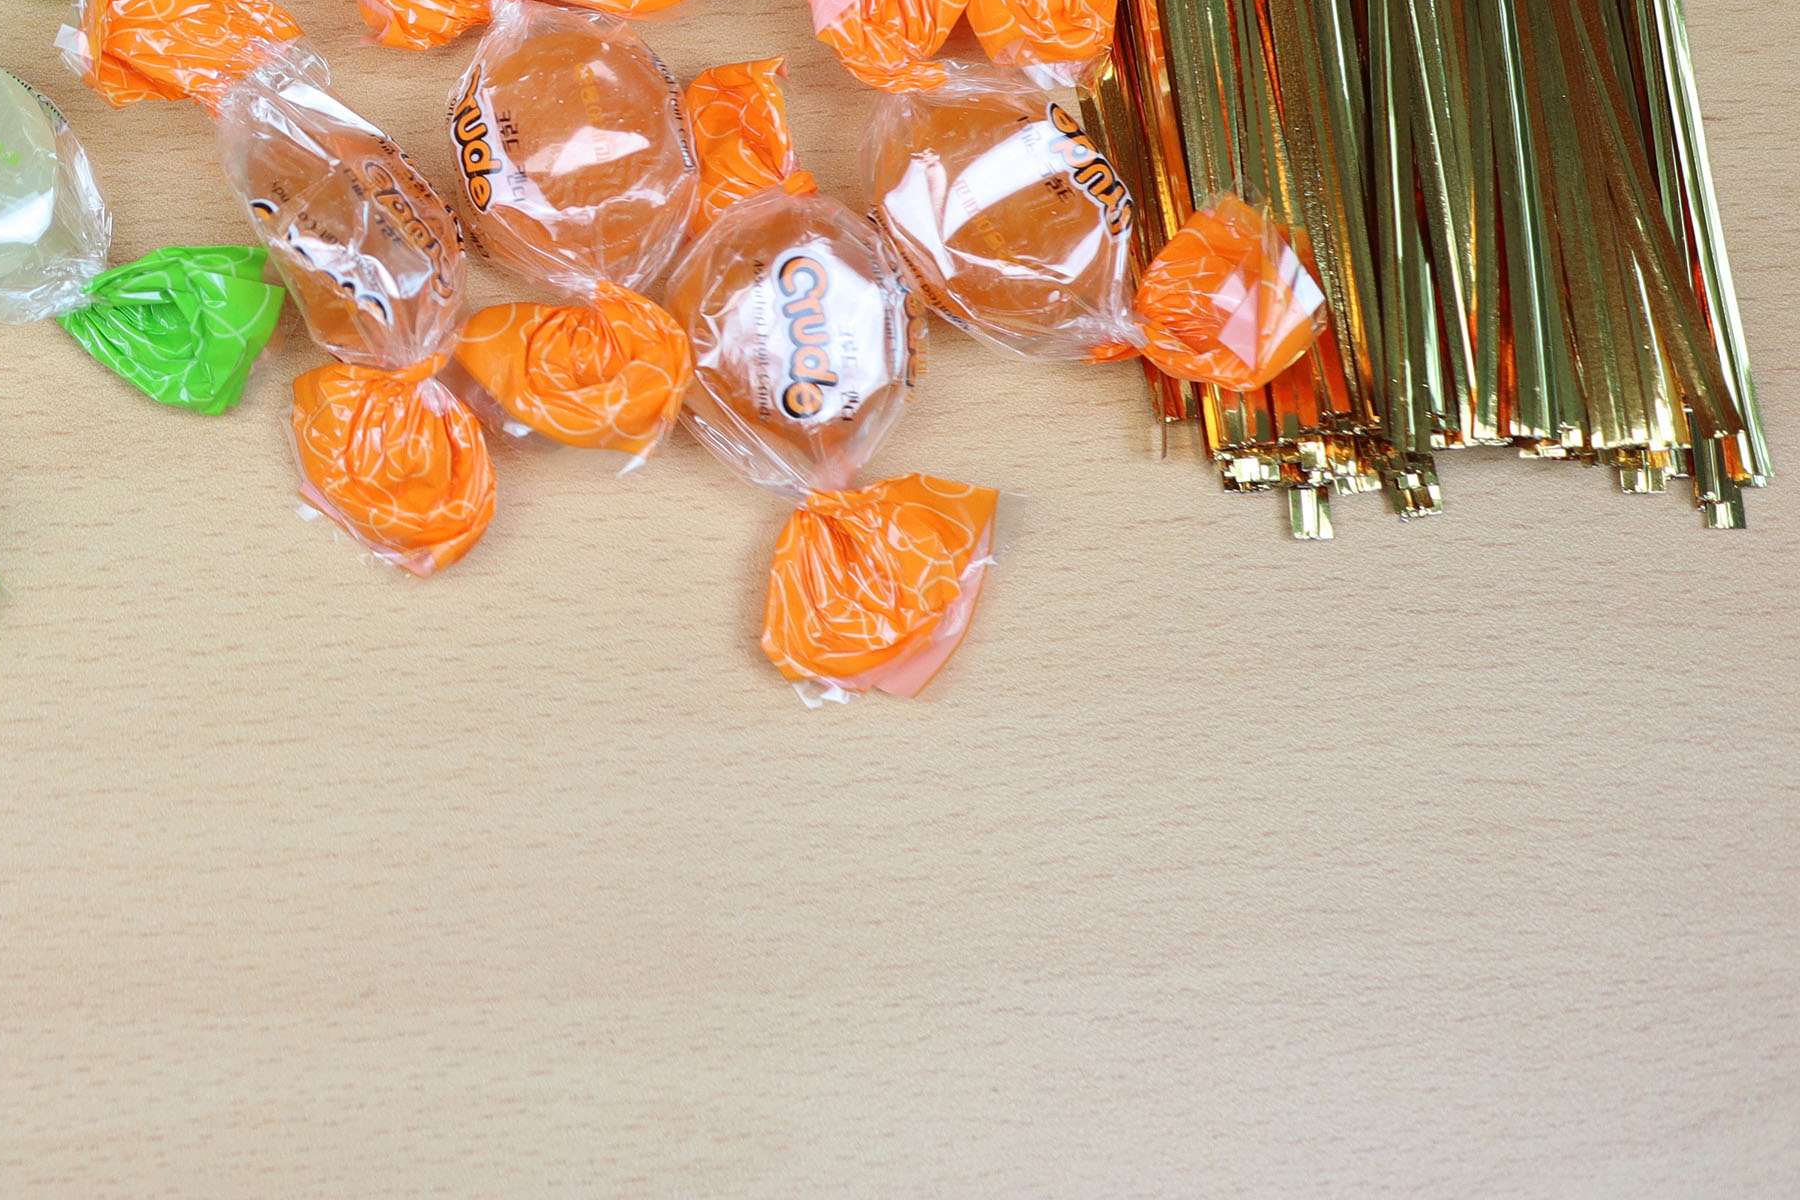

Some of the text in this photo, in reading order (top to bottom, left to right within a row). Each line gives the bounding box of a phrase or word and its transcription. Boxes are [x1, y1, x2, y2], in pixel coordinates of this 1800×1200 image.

[496, 108, 527, 204] 크루드 캔디
[1050, 102, 1133, 235] Crude
[778, 255, 840, 419] Crude
